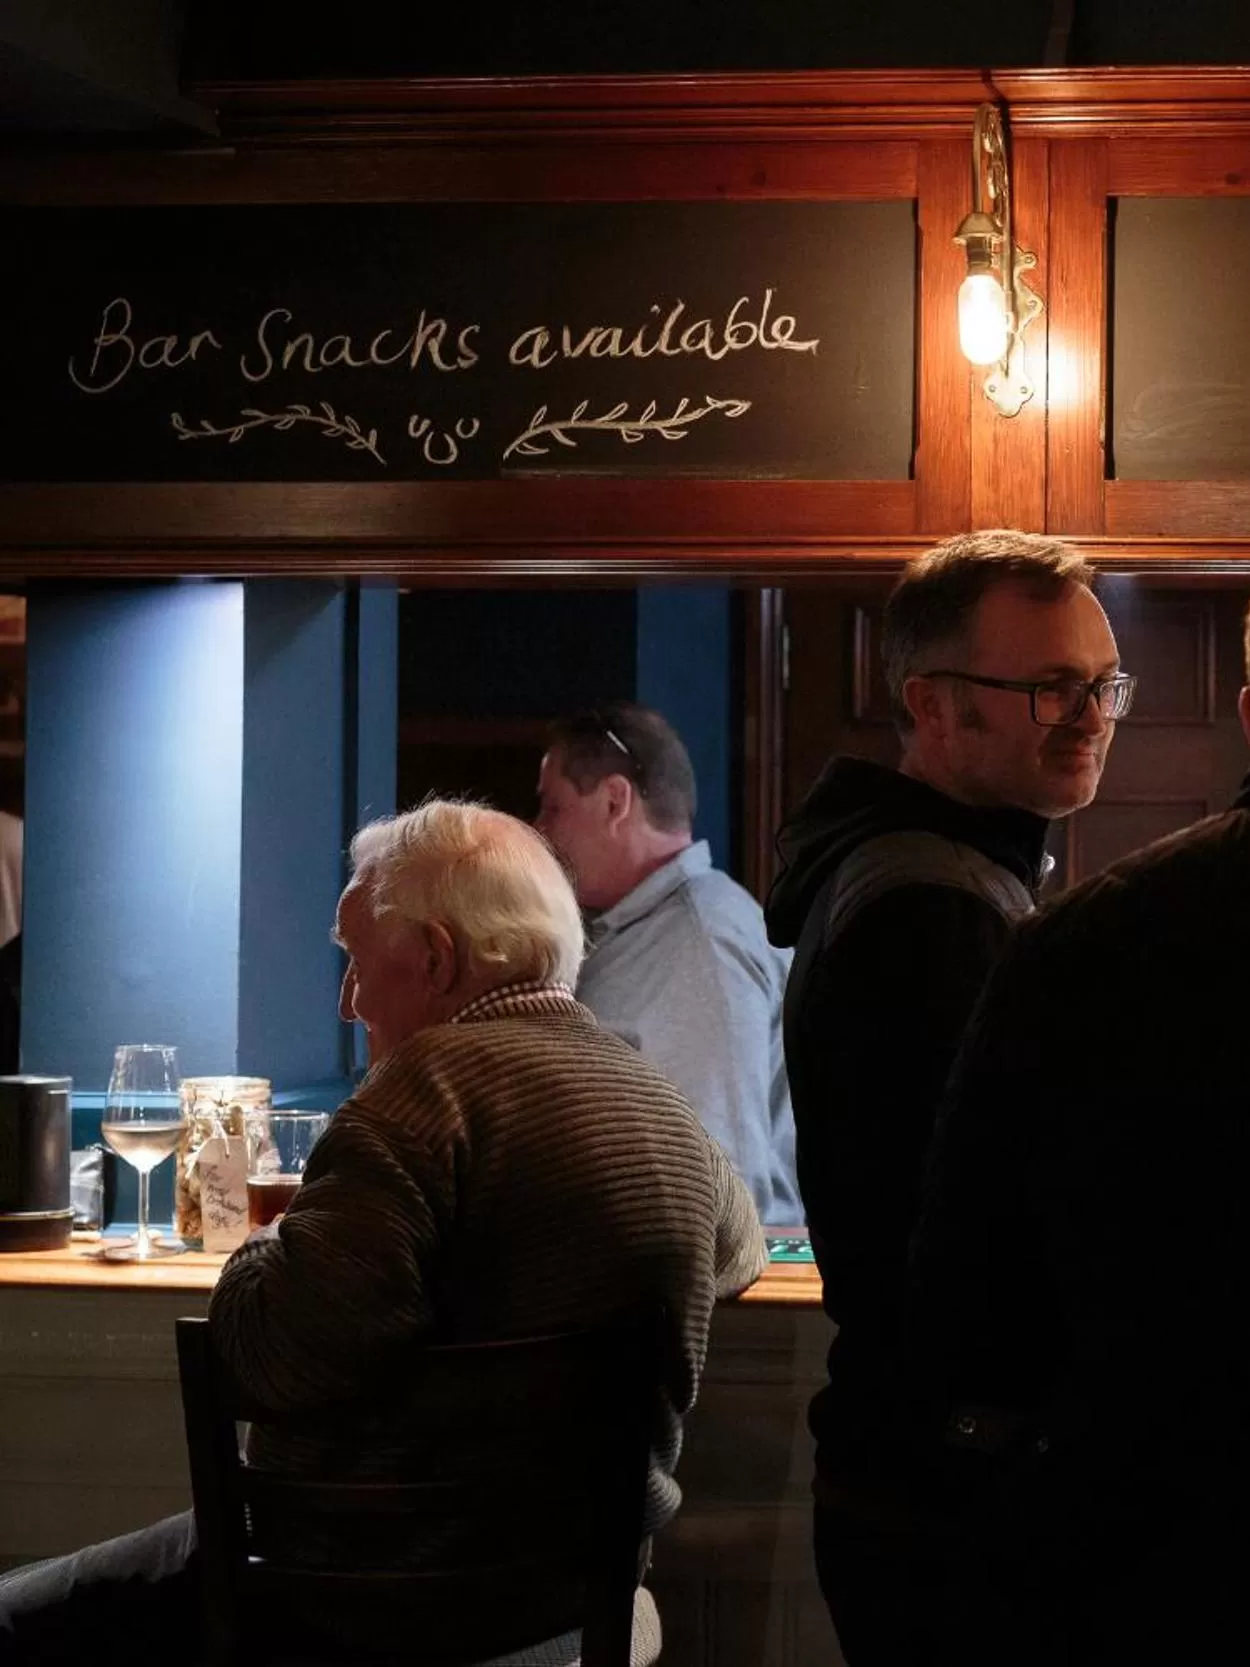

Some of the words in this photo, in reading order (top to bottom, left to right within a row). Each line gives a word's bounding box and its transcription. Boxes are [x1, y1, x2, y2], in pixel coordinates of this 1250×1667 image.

[68, 298, 222, 394] Bar
[241, 307, 481, 382] Snacks
[508, 288, 820, 369] available
